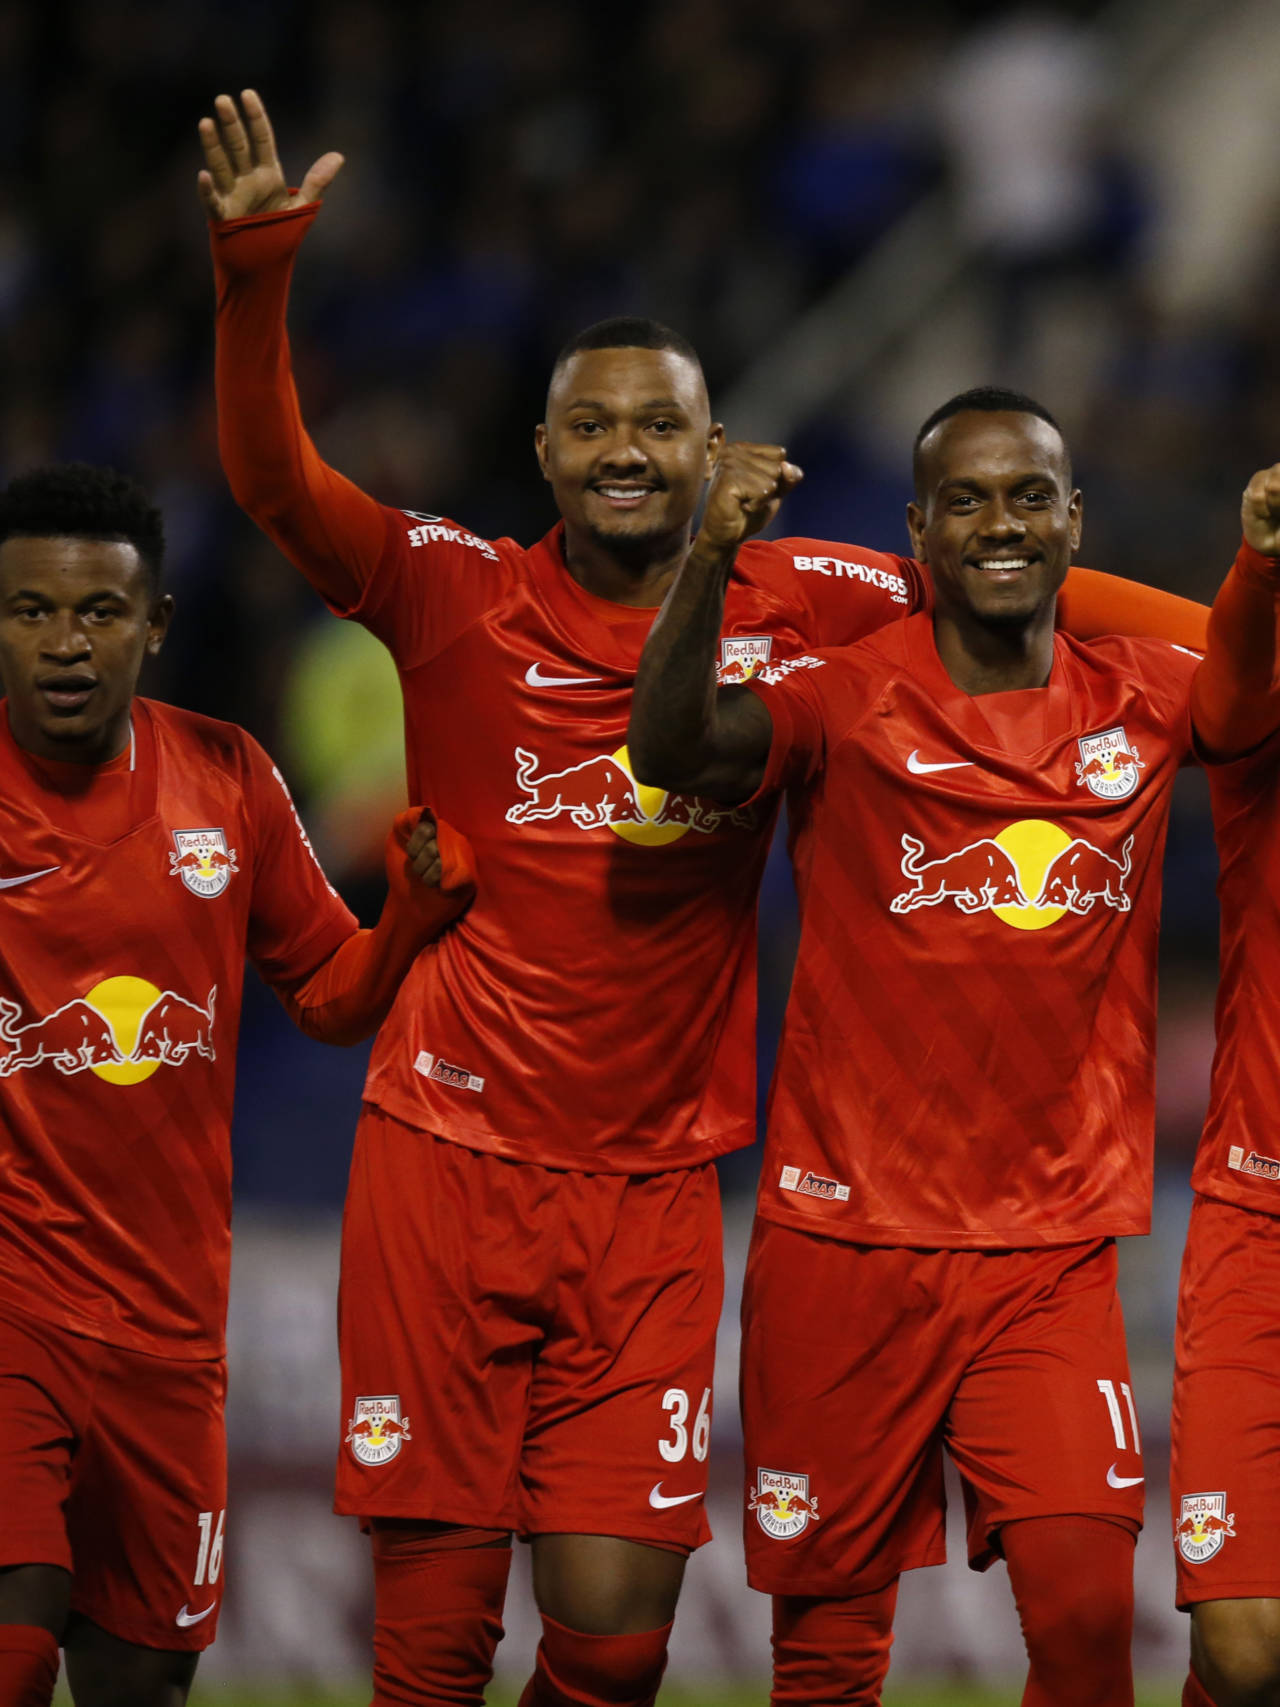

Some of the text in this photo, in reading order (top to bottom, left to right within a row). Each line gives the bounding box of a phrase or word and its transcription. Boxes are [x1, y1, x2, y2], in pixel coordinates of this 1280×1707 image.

[793, 556, 908, 596] BETPIX365
[1094, 772, 1132, 793] BRAGANTINO
[431, 1066, 468, 1088] ASAS
[1244, 1159, 1279, 1178] ASAS
[800, 1179, 836, 1198] ASAS
[657, 1386, 711, 1463] 36
[1096, 1379, 1140, 1456] 11
[764, 1511, 803, 1534] BRAGANTINO
[193, 1508, 225, 1586] 16
